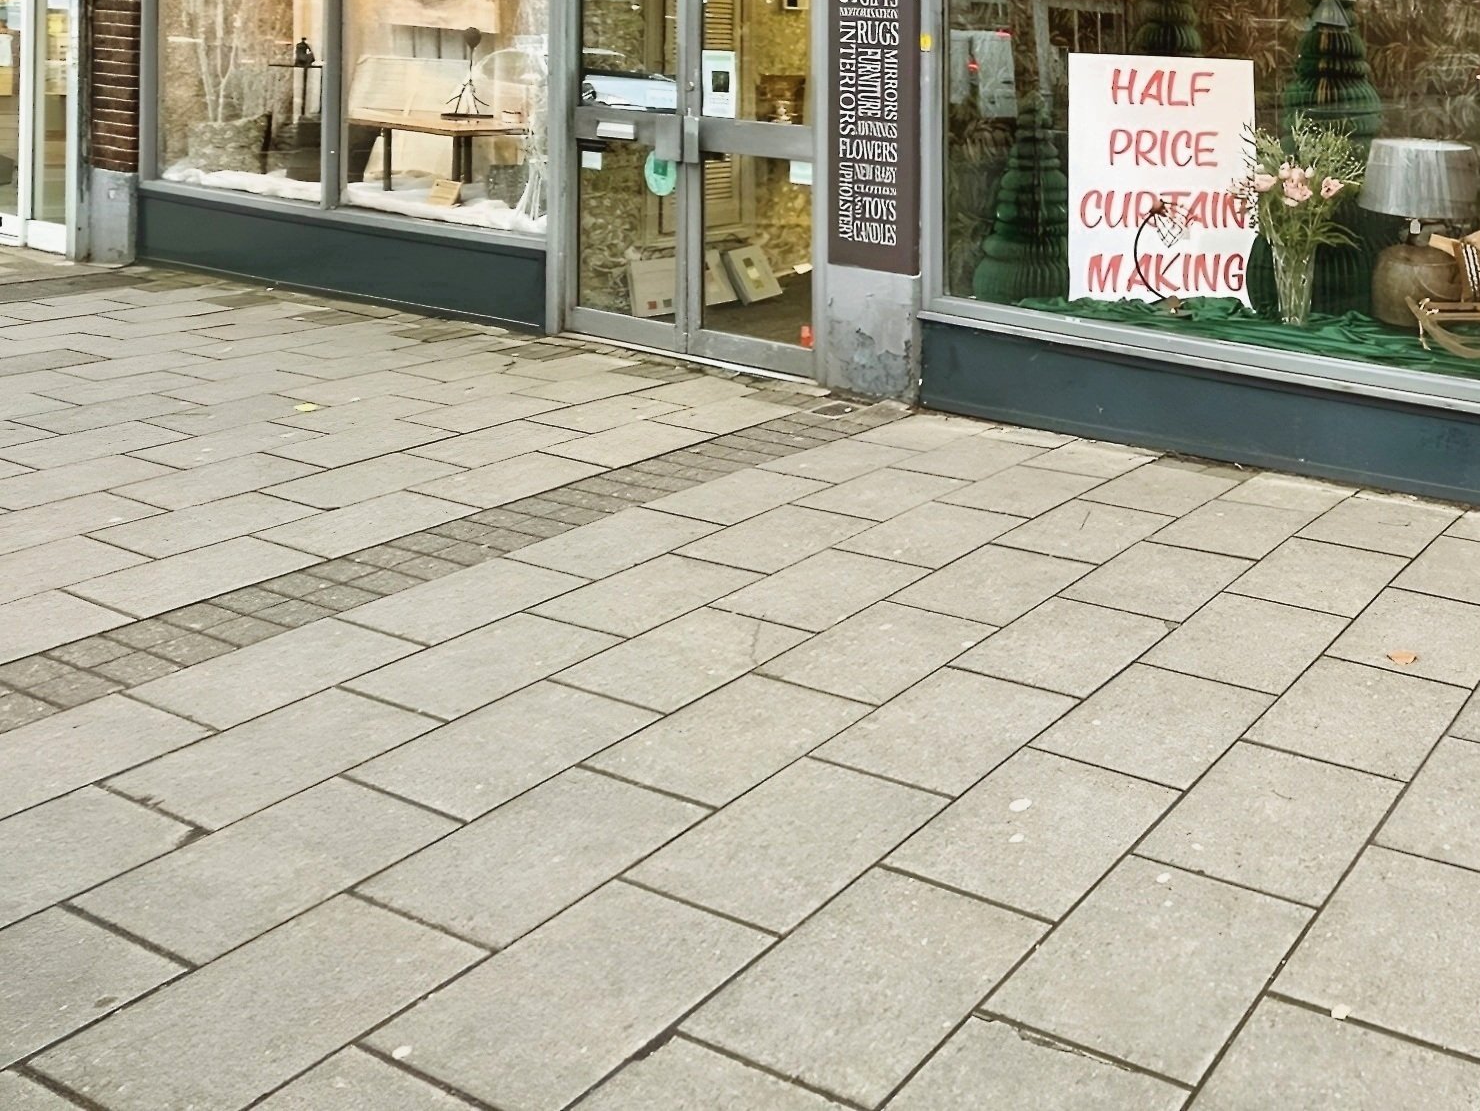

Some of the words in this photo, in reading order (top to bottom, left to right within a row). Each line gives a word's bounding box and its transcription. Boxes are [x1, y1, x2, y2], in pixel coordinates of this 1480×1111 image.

[857, 21, 899, 46] RUGS
[839, 21, 856, 136] INTERIORS
[858, 48, 881, 117] FURNITURE
[884, 50, 898, 120] MIRRORS
[1111, 68, 1215, 106] HALF
[839, 137, 897, 163] FLOWERS
[1109, 129, 1219, 167] PRICE
[854, 163, 873, 180] NEW
[875, 165, 896, 183] BABY
[839, 161, 853, 241] UPHOLSTERY
[862, 196, 896, 221] TOYS
[1080, 190, 1247, 229] CURTAIN
[853, 220, 897, 246] CANDLES
[1087, 252, 1245, 293] MAKING
